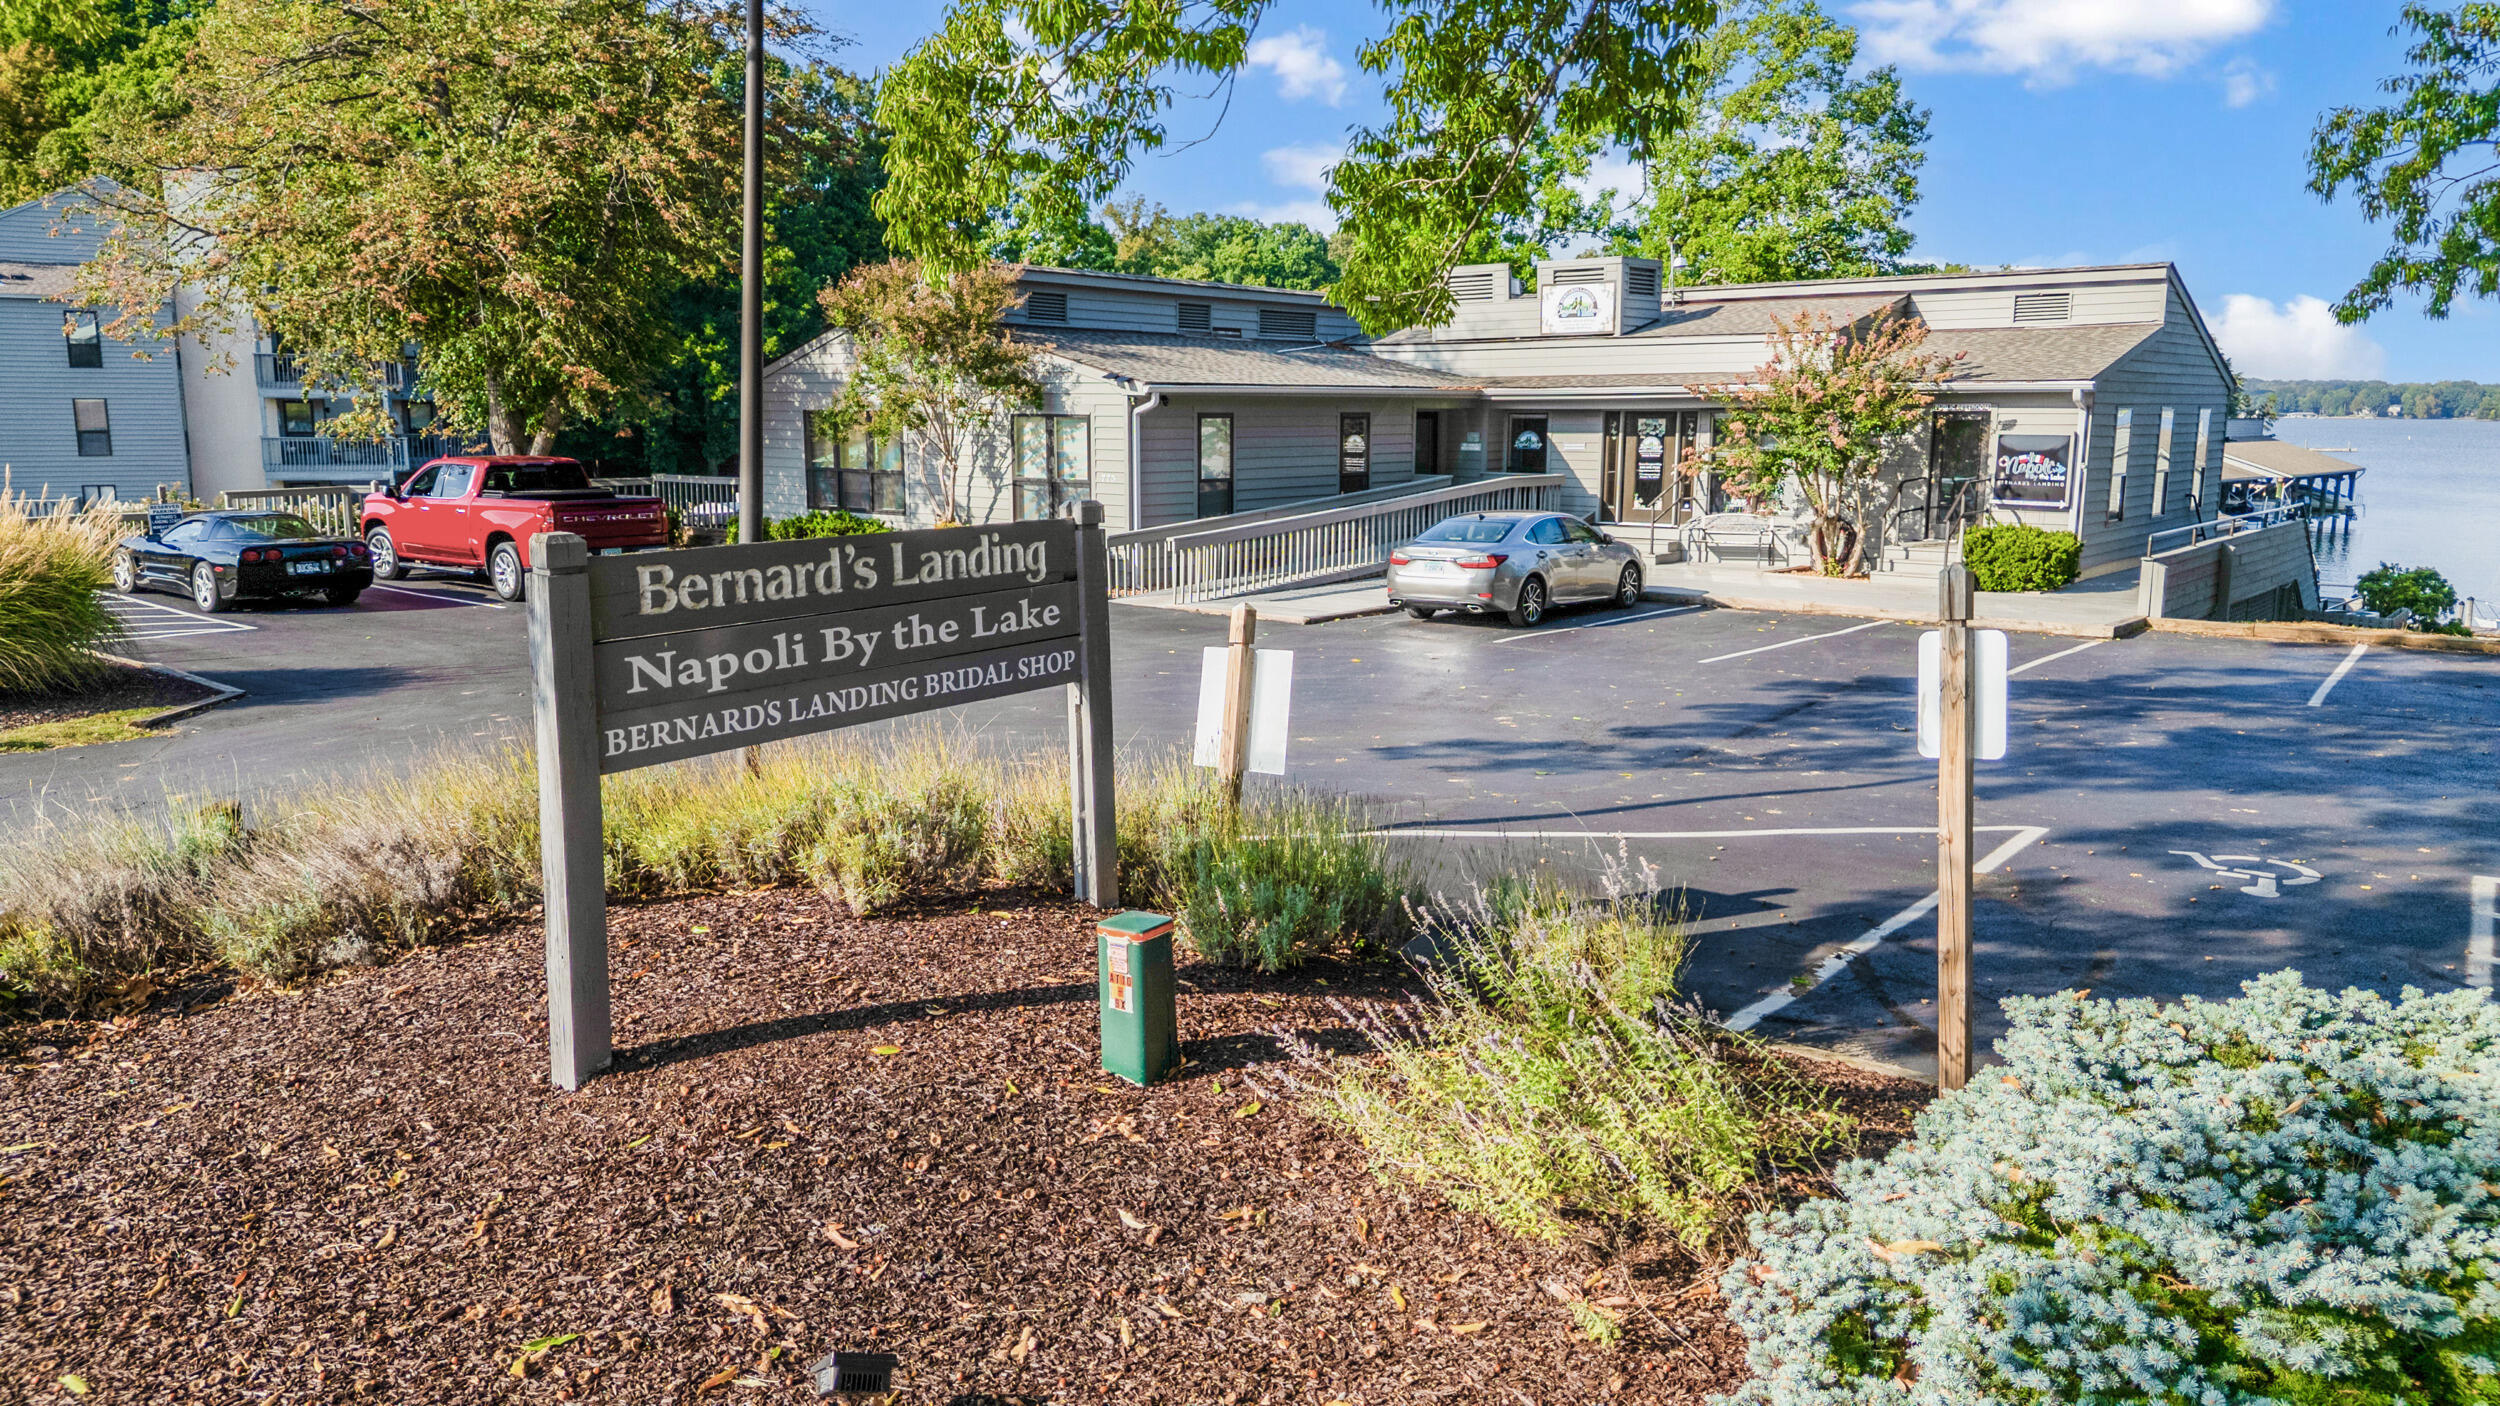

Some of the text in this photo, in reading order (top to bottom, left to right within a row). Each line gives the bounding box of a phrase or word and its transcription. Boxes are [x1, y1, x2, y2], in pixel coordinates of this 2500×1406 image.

[563, 512, 657, 522] CHEVROLET
[636, 532, 1047, 615] Bernard's Landing
[624, 598, 1061, 694] Napoli By the Lake
[605, 650, 1076, 757] BERNARD'S LANDING BRIDAL SHOP
